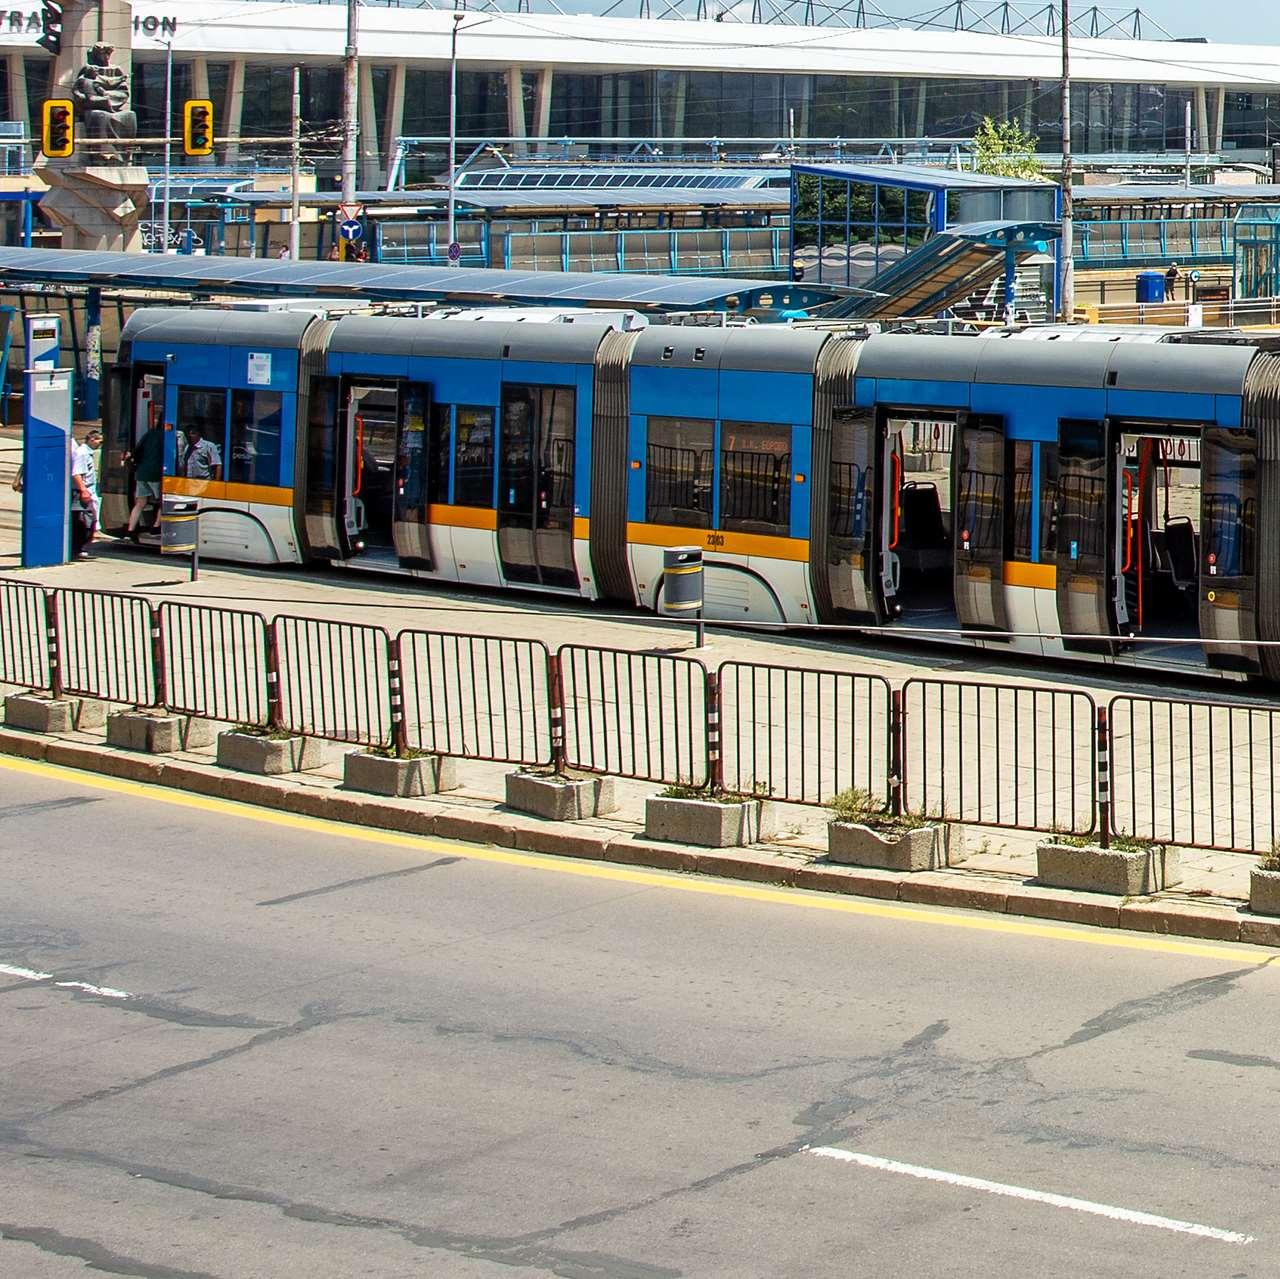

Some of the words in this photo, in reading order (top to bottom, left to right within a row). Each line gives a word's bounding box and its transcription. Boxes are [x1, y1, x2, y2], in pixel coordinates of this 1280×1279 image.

[0, 10, 42, 28] TRA
[134, 15, 177, 32] ION
[728, 435, 736, 451] 7
